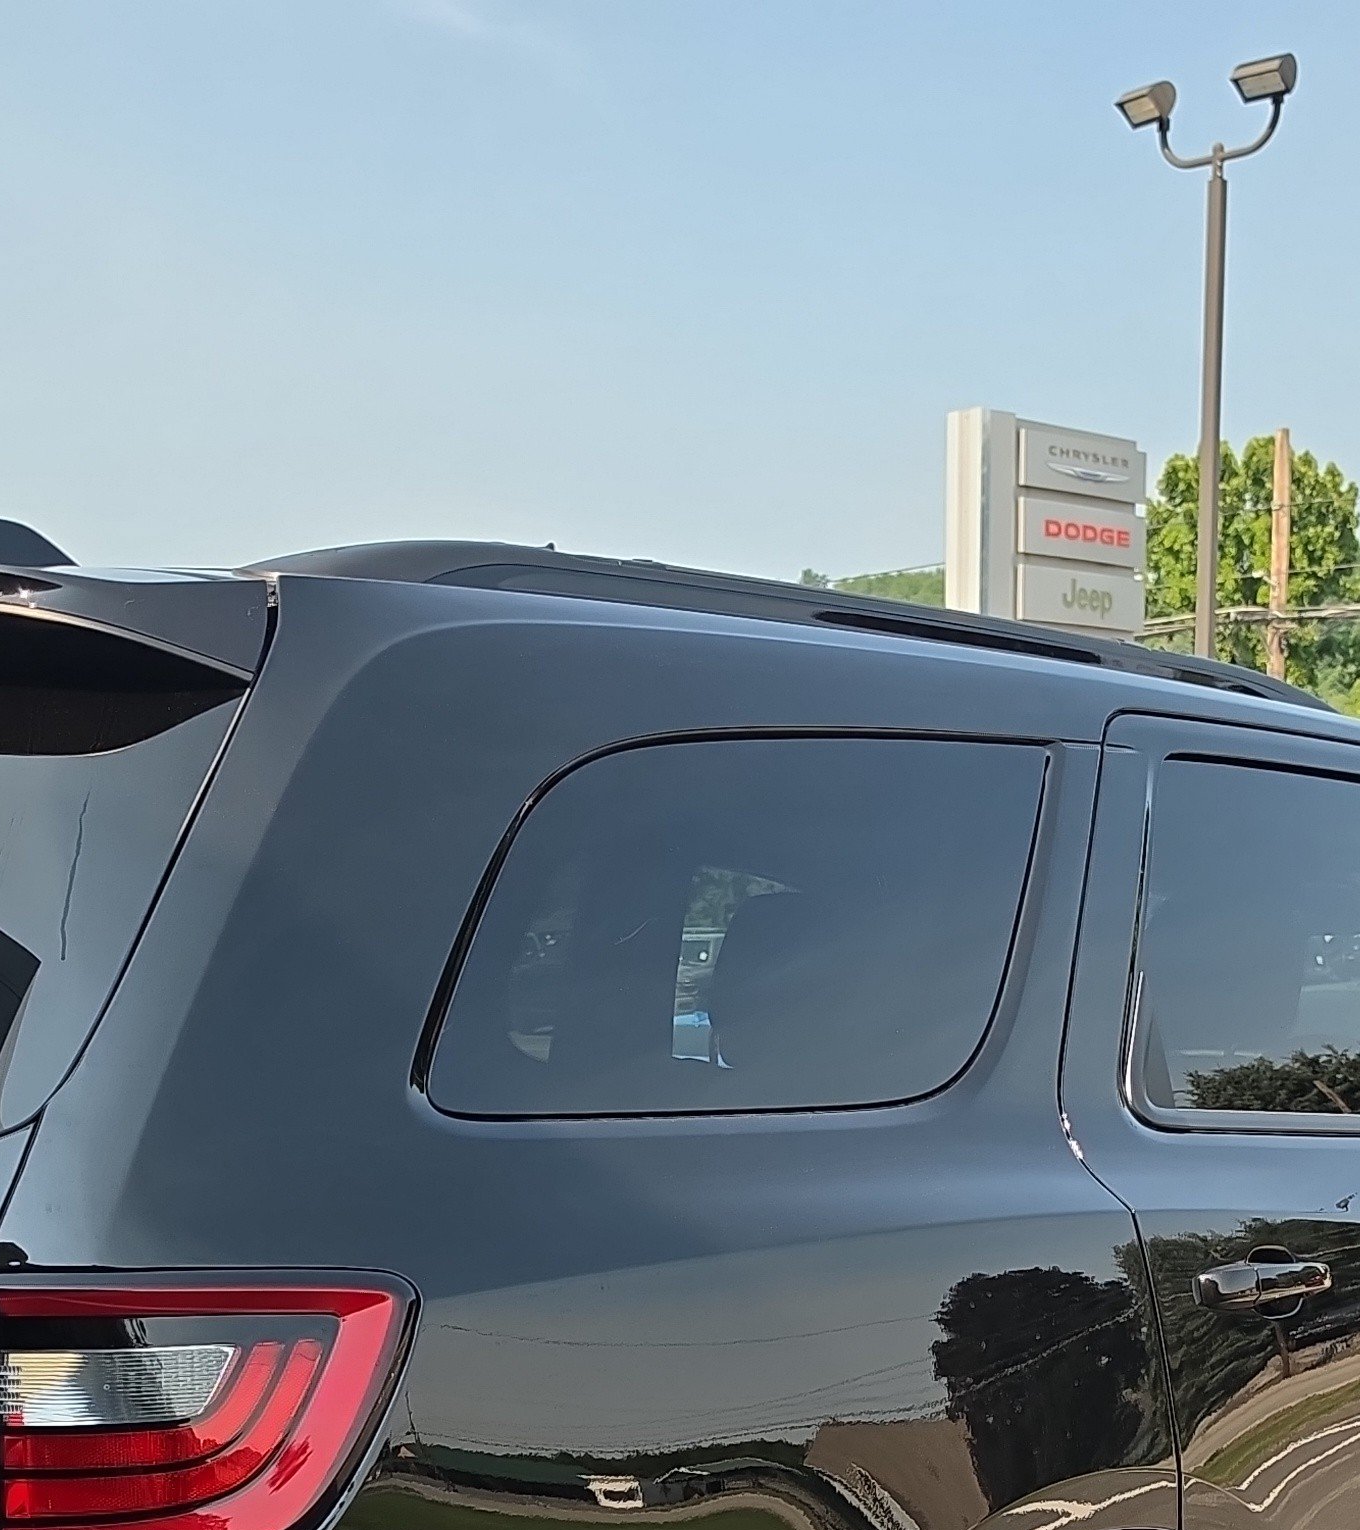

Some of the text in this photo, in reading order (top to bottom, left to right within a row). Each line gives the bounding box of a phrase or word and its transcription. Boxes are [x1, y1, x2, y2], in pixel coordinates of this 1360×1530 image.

[1048, 445, 1129, 468] CHRYSLER
[1044, 519, 1130, 548] DODGE
[1061, 578, 1113, 618] Jeep
